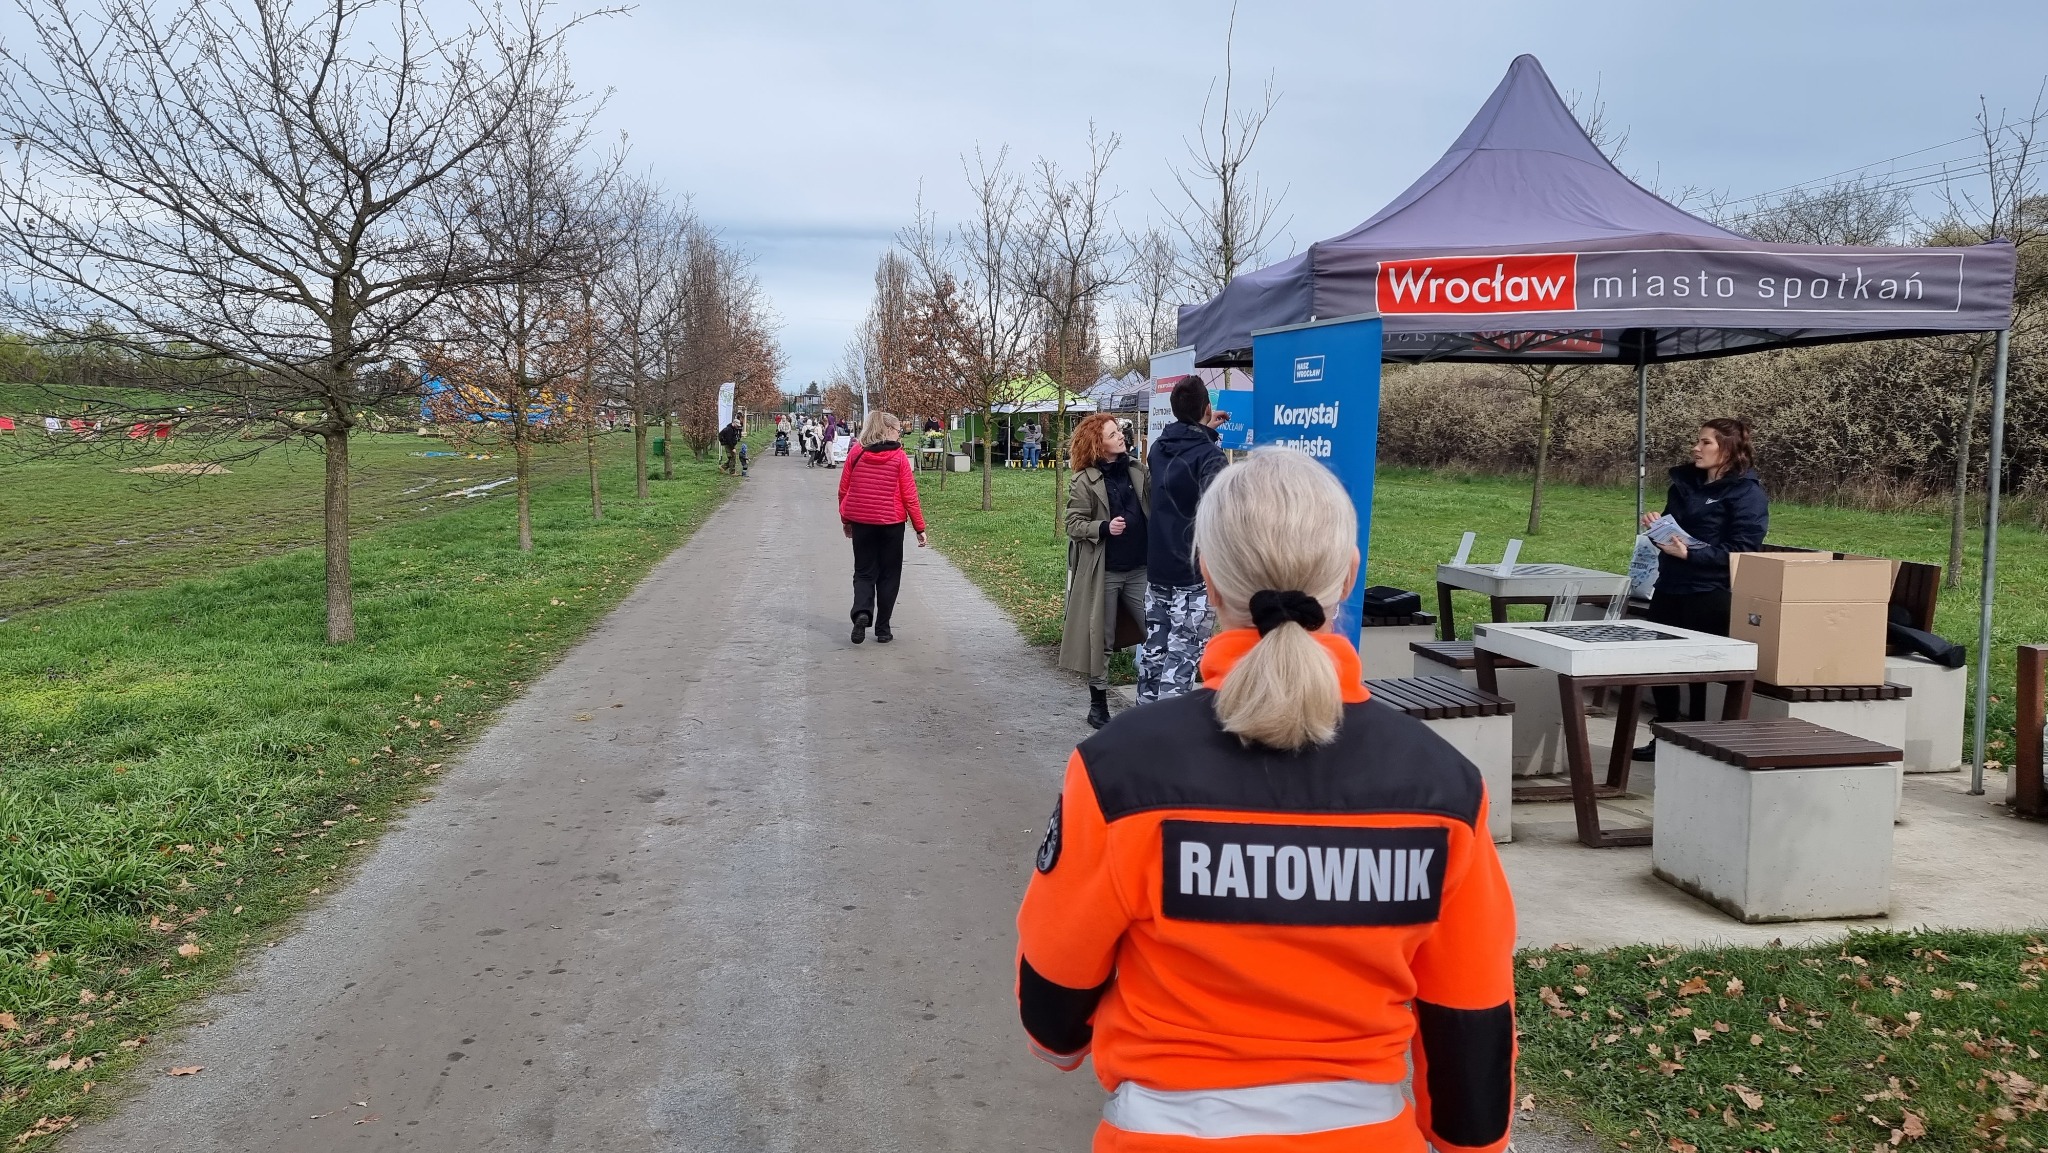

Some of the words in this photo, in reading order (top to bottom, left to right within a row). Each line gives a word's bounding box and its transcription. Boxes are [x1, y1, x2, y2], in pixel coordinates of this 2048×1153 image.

[1388, 263, 1566, 304] Wrocław
[1593, 268, 1735, 299] miasto
[1757, 266, 1923, 308] spotkań
[1296, 362, 1310, 371] NASZ
[1296, 368, 1321, 378] WROCŁAW
[1273, 400, 1340, 429] Korzystaj
[1287, 434, 1332, 457] miasta
[1179, 841, 1435, 902] RATOWNIK
